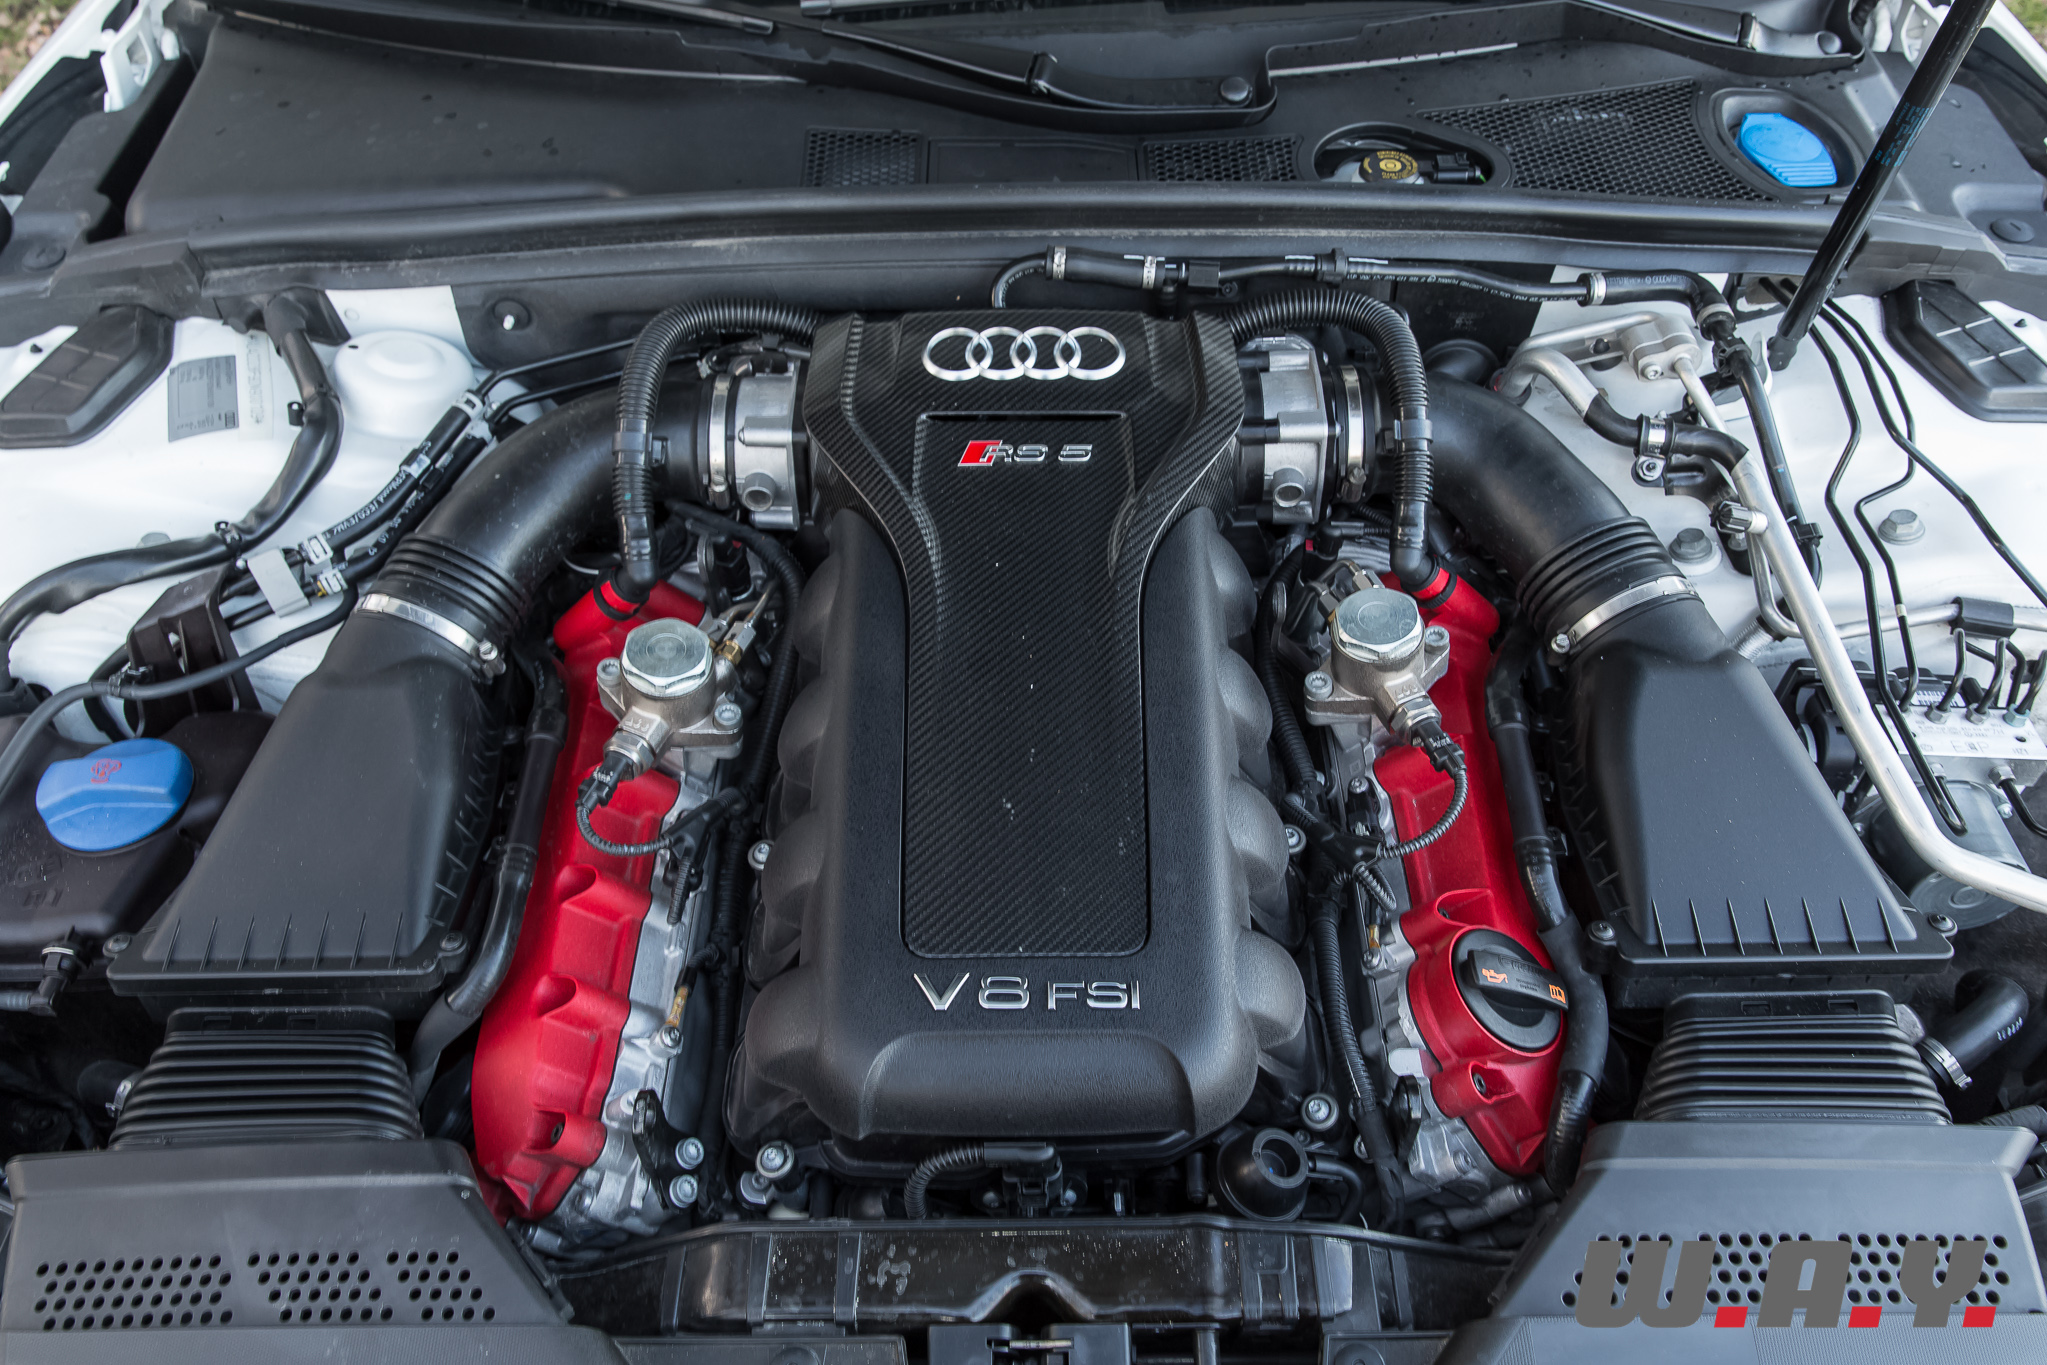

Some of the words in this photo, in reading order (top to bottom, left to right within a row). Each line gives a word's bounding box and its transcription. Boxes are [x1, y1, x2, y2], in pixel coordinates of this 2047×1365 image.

[977, 442, 1049, 464] RS
[1057, 443, 1093, 463] 5
[913, 971, 1030, 1011] V8
[1047, 980, 1141, 1011] FSI
